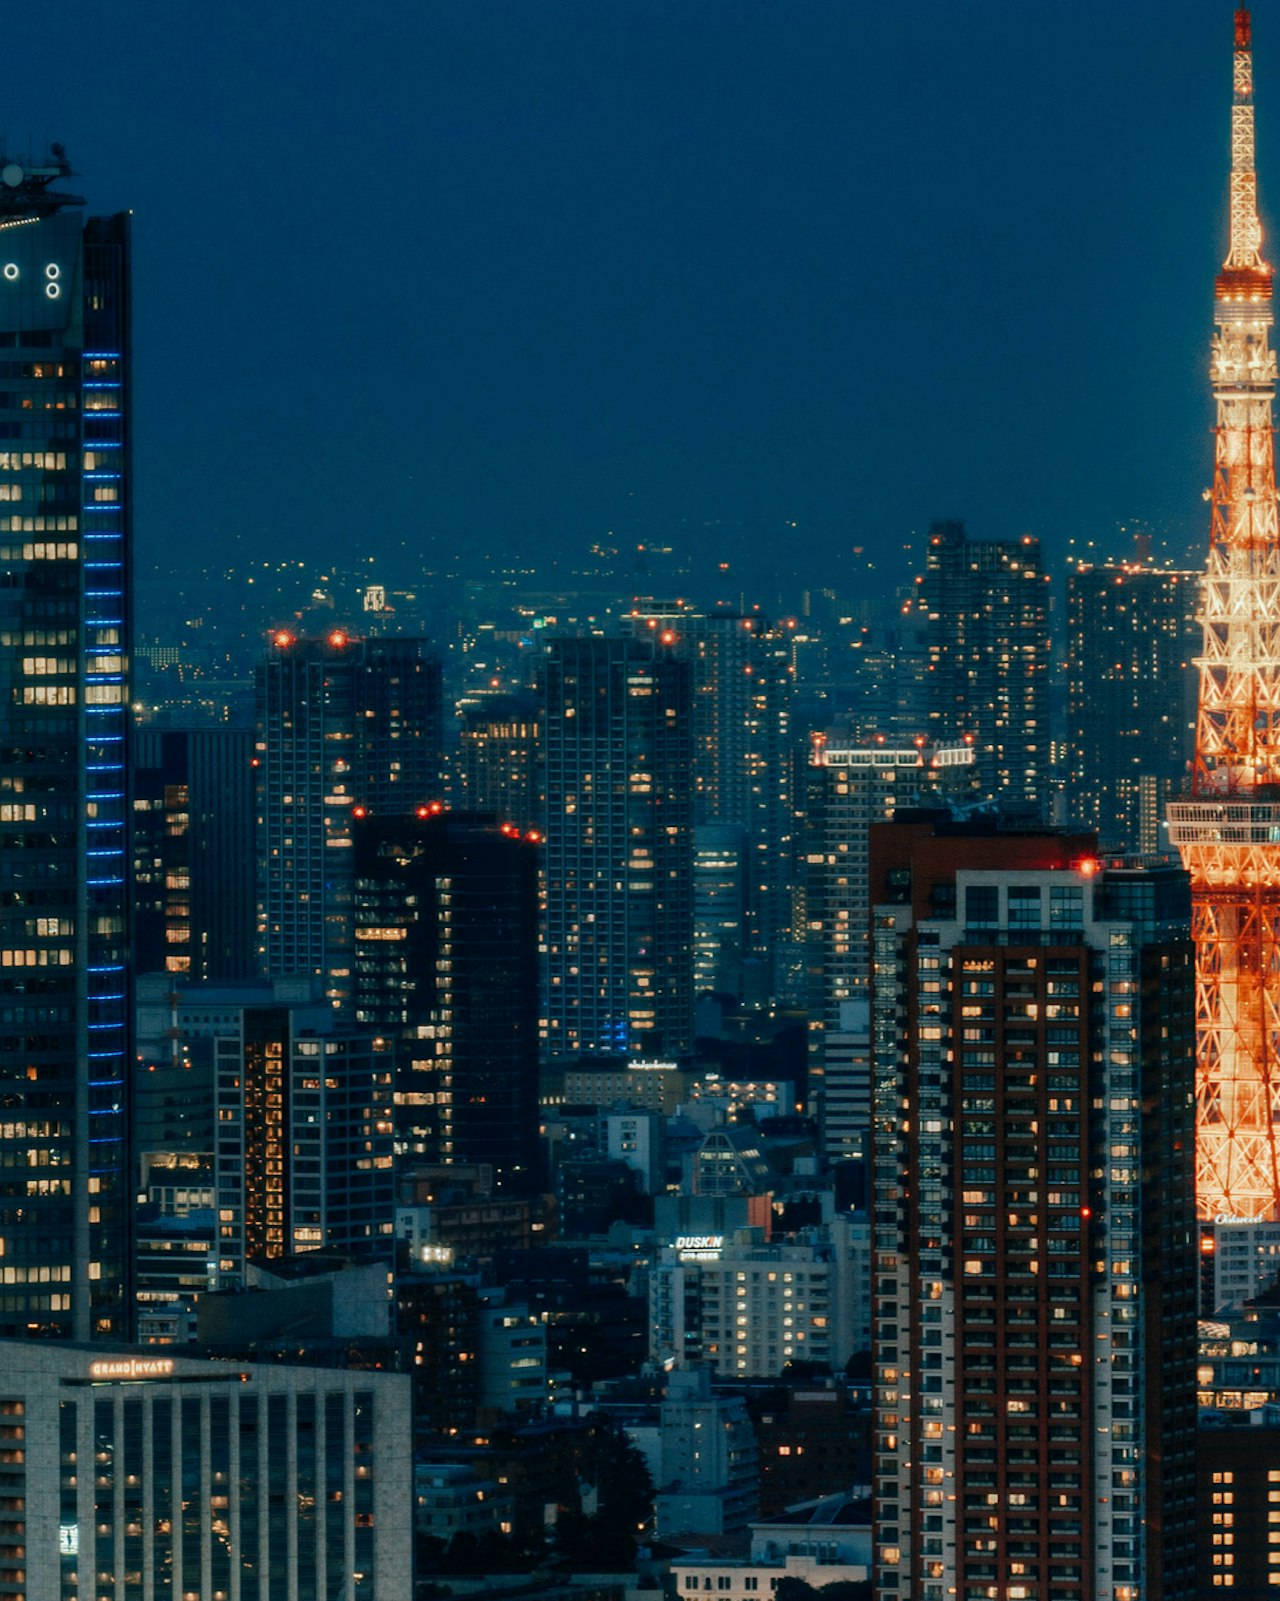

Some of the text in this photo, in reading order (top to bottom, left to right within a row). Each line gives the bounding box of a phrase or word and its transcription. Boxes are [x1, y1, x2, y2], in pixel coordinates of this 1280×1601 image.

[676, 1236, 723, 1248] DUSKIN
[93, 1359, 173, 1374] GRAND HYATT
